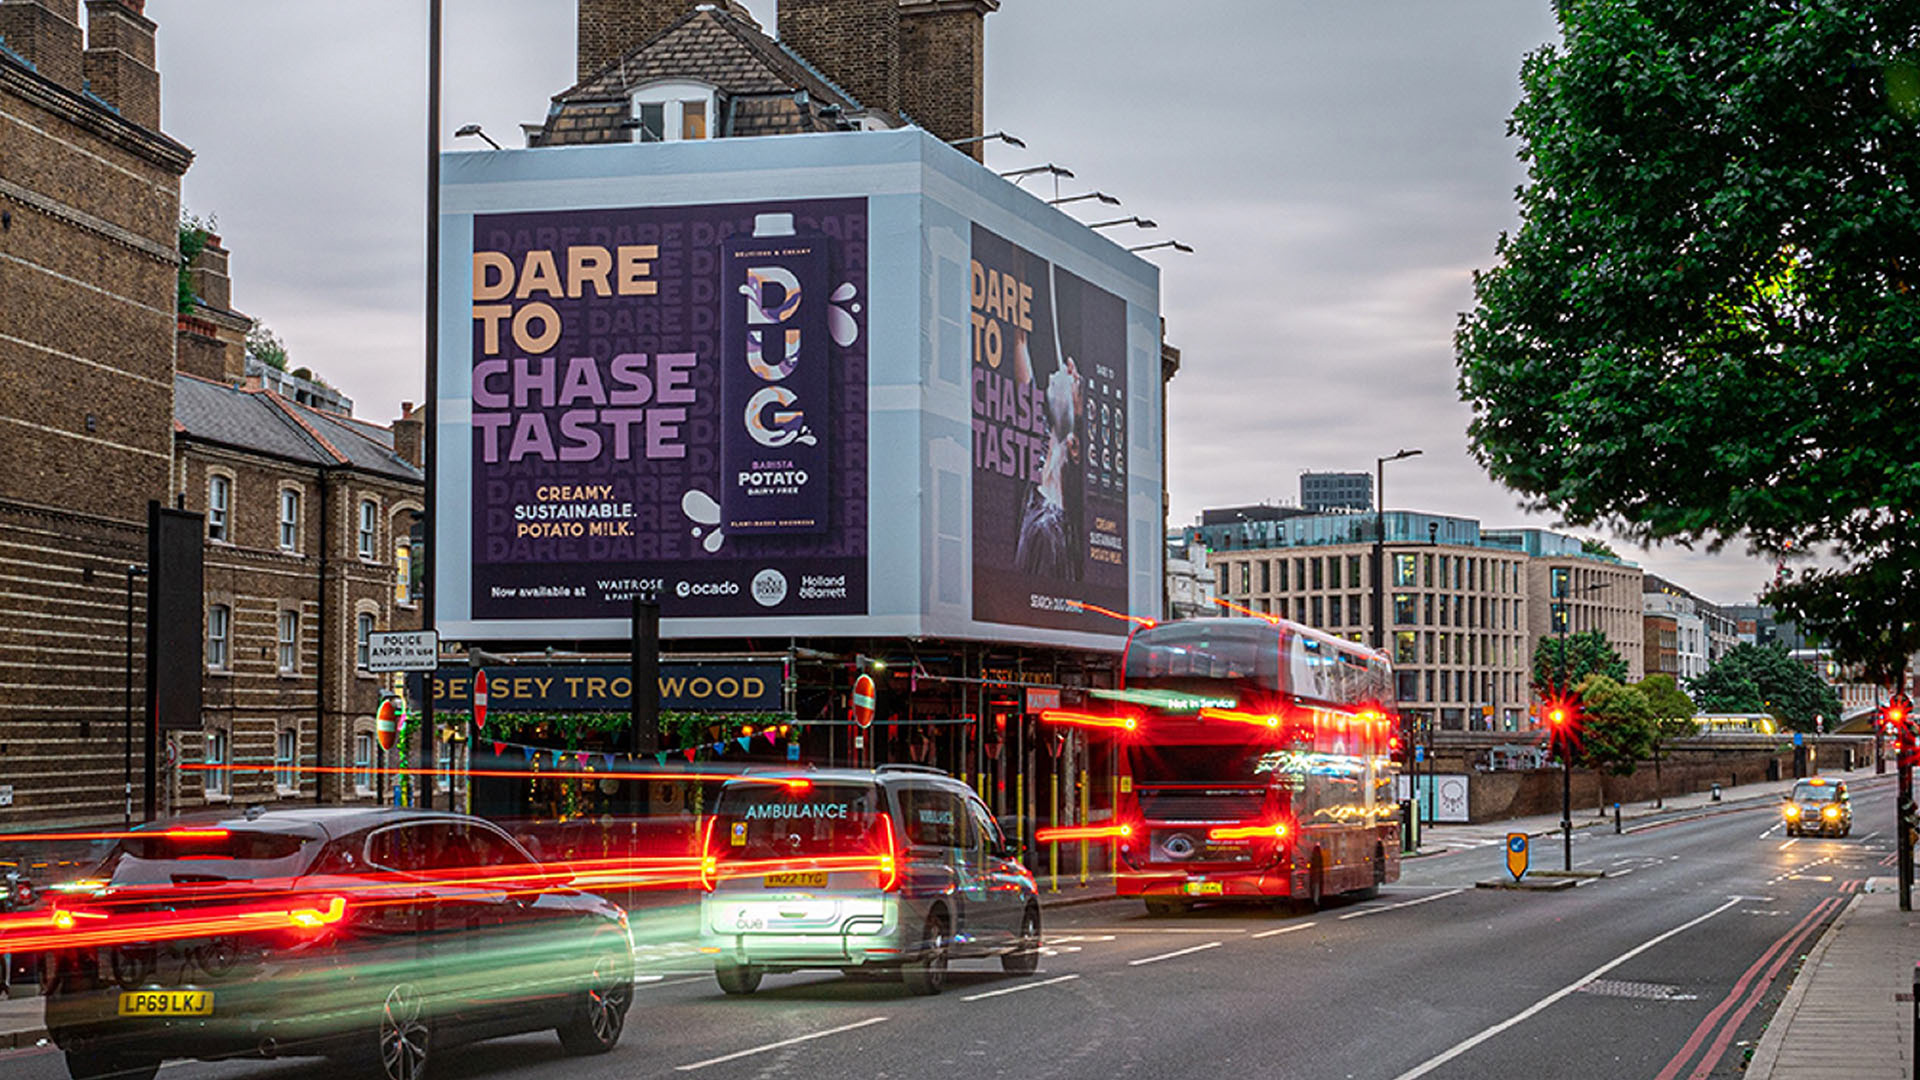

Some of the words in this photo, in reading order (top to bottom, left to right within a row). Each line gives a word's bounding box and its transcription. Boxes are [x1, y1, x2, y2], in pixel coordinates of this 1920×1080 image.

[473, 244, 659, 301] DARE
[971, 258, 1032, 332] DARE
[473, 301, 562, 355] TO
[971, 311, 1002, 368] TO
[472, 353, 697, 408] CHASE
[972, 367, 1046, 434] CHASE
[472, 408, 687, 463] TASTE
[972, 418, 1042, 485] TASTE
[752, 461, 794, 470] BARISTA
[738, 470, 809, 486] POTATO
[536, 485, 615, 501] CREAMY.
[514, 503, 638, 520] SUSTAINABLE.
[517, 522, 584, 538] POTATO
[597, 579, 664, 590] WAITROSE
[691, 581, 739, 595] ocado
[802, 576, 845, 587] Holland
[491, 587, 516, 598] Now
[519, 586, 571, 597] available
[574, 586, 587, 597] at
[383, 635, 422, 646] POLICE
[372, 647, 402, 657] ANPR
[433, 677, 553, 699] BESEY
[564, 676, 766, 699] TROWOOD
[1168, 698, 1187, 709] Not
[745, 803, 848, 820] AMBULANCE
[125, 994, 168, 1012] LP69
[172, 994, 206, 1011] LKJ
